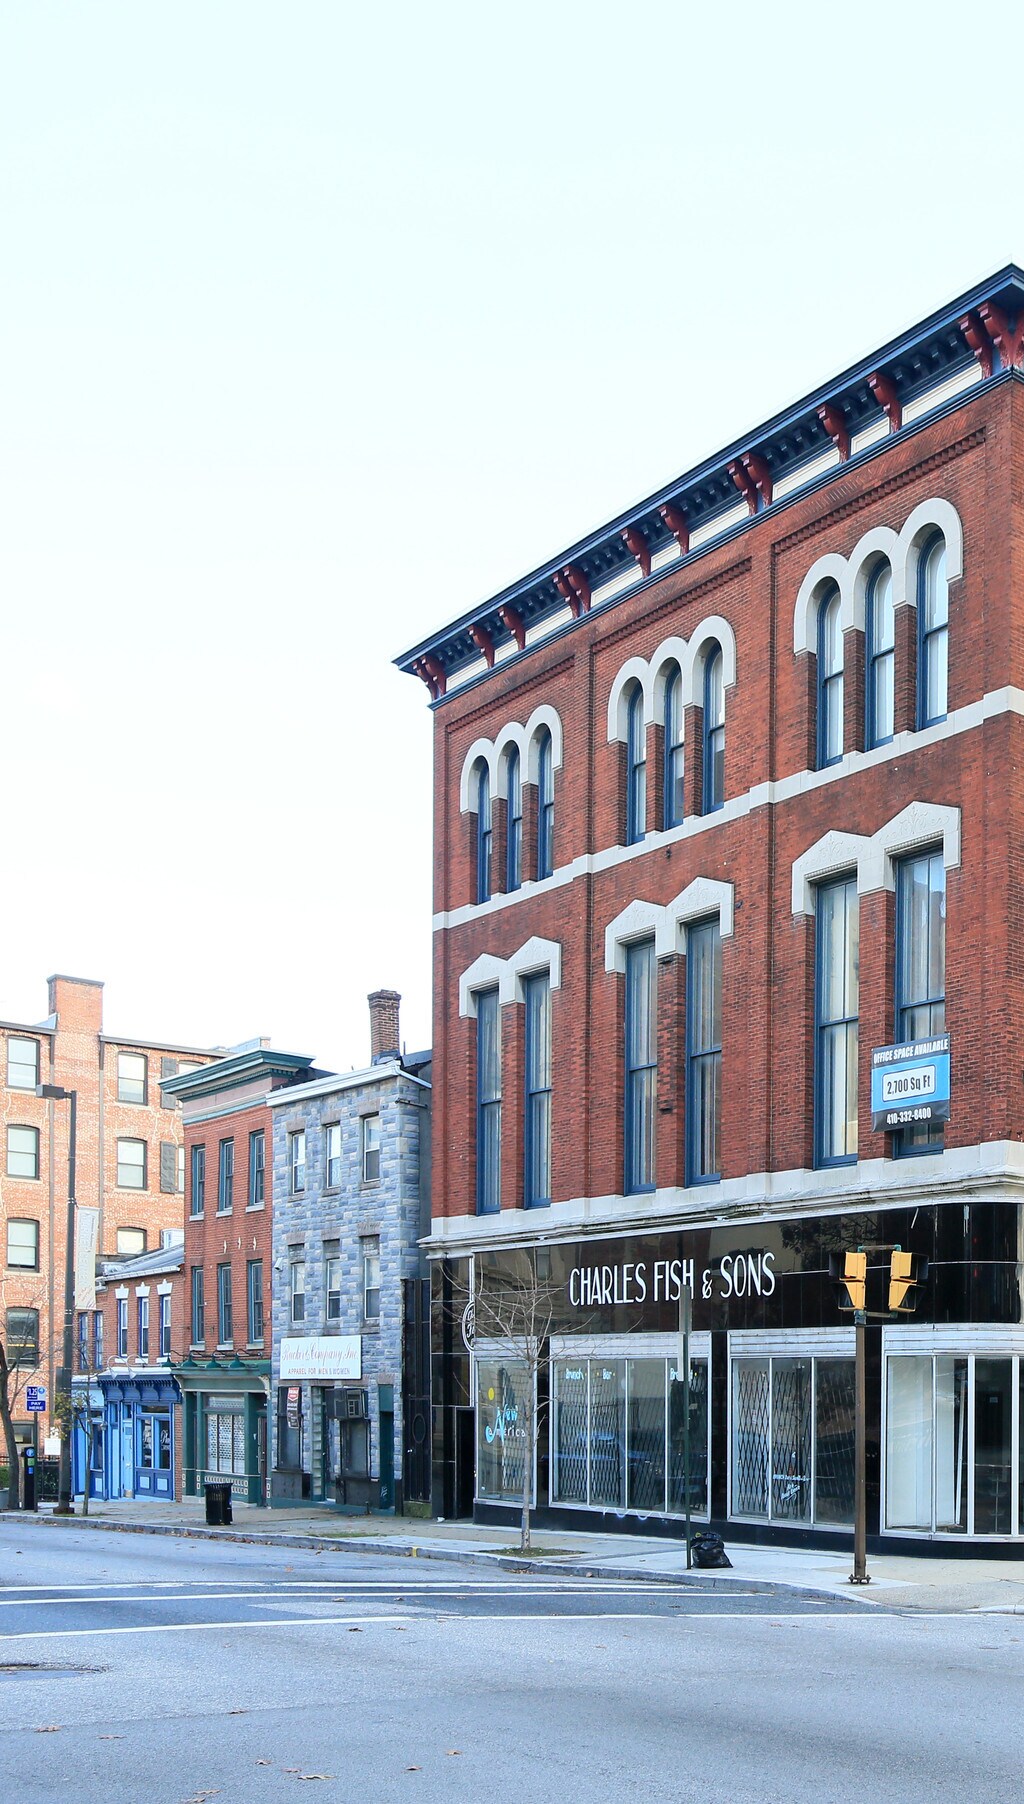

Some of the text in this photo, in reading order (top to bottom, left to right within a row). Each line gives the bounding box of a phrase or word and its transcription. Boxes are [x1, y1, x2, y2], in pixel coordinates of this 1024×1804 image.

[873, 1039, 949, 1064] OFFICE SPACE AVAILABLE
[887, 1075, 931, 1095] 2,700 Sq Ft
[886, 1107, 932, 1125] 410-332-8400
[569, 1252, 776, 1306] CHARLES FISH & SONS
[485, 1403, 519, 1447] New
